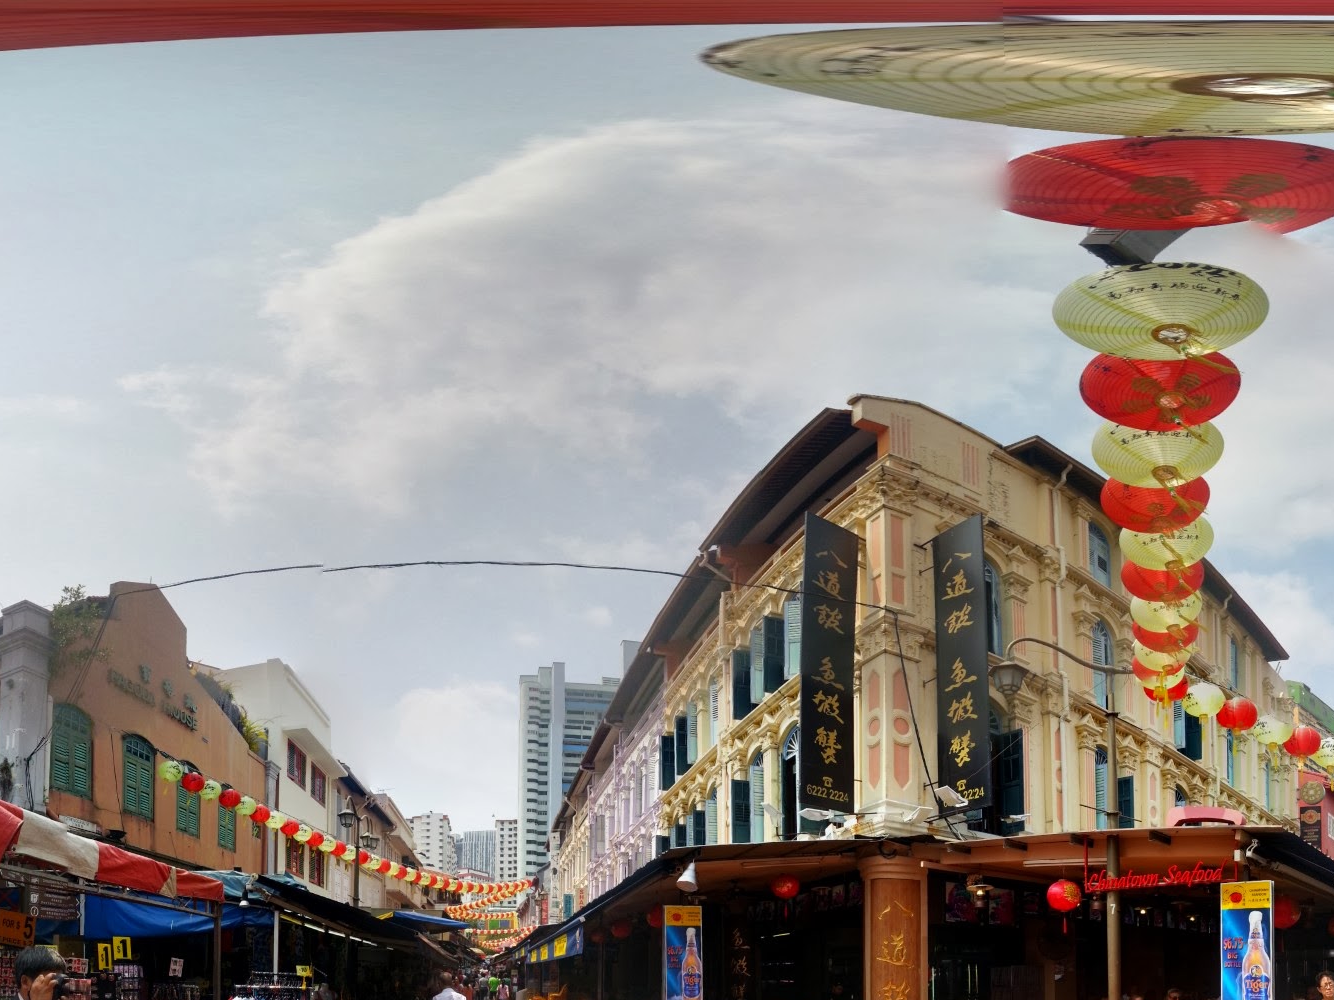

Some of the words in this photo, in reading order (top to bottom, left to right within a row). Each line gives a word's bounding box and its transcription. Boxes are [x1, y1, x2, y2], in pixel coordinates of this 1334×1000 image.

[806, 784, 828, 798] 6222
[829, 789, 849, 803] 2224
[1088, 869, 1159, 891] Chinatown
[1163, 858, 1229, 887] Seafood
[1110, 903, 1116, 915] 7
[2, 918, 14, 929] FOR
[24, 917, 33, 940] 5
[1223, 937, 1244, 950] $6.75
[1246, 980, 1269, 992] Tiger
